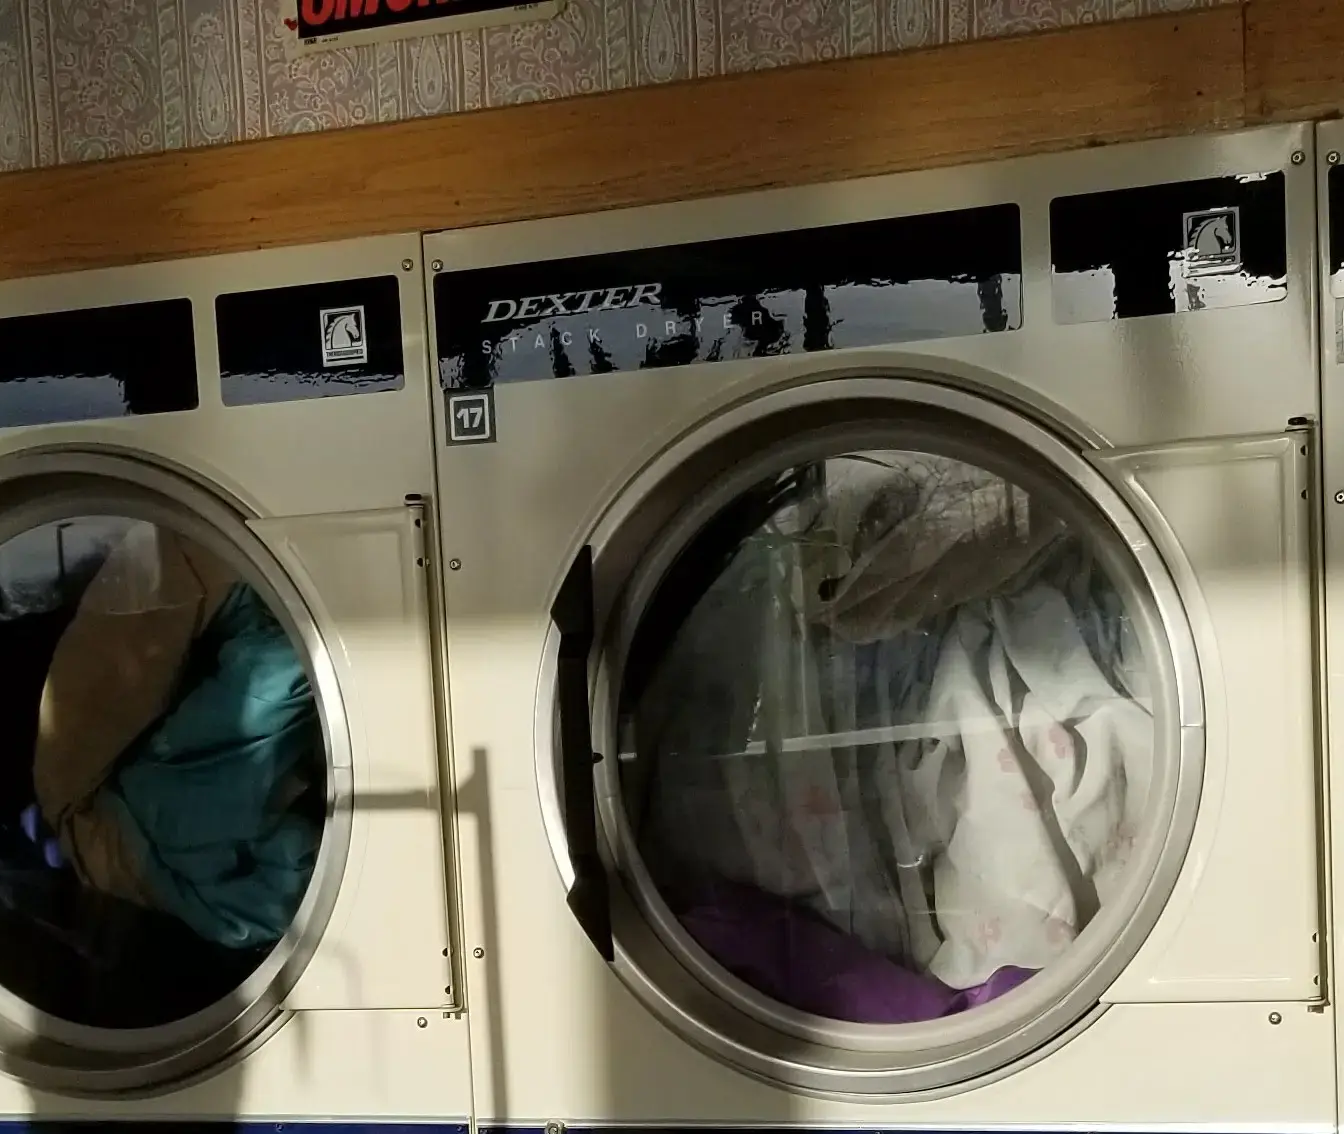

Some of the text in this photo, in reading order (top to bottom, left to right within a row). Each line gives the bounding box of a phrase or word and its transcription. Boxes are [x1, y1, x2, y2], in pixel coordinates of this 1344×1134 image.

[480, 282, 663, 324] DEXTER
[481, 310, 763, 355] STACK DRYER
[455, 406, 484, 430] 17
